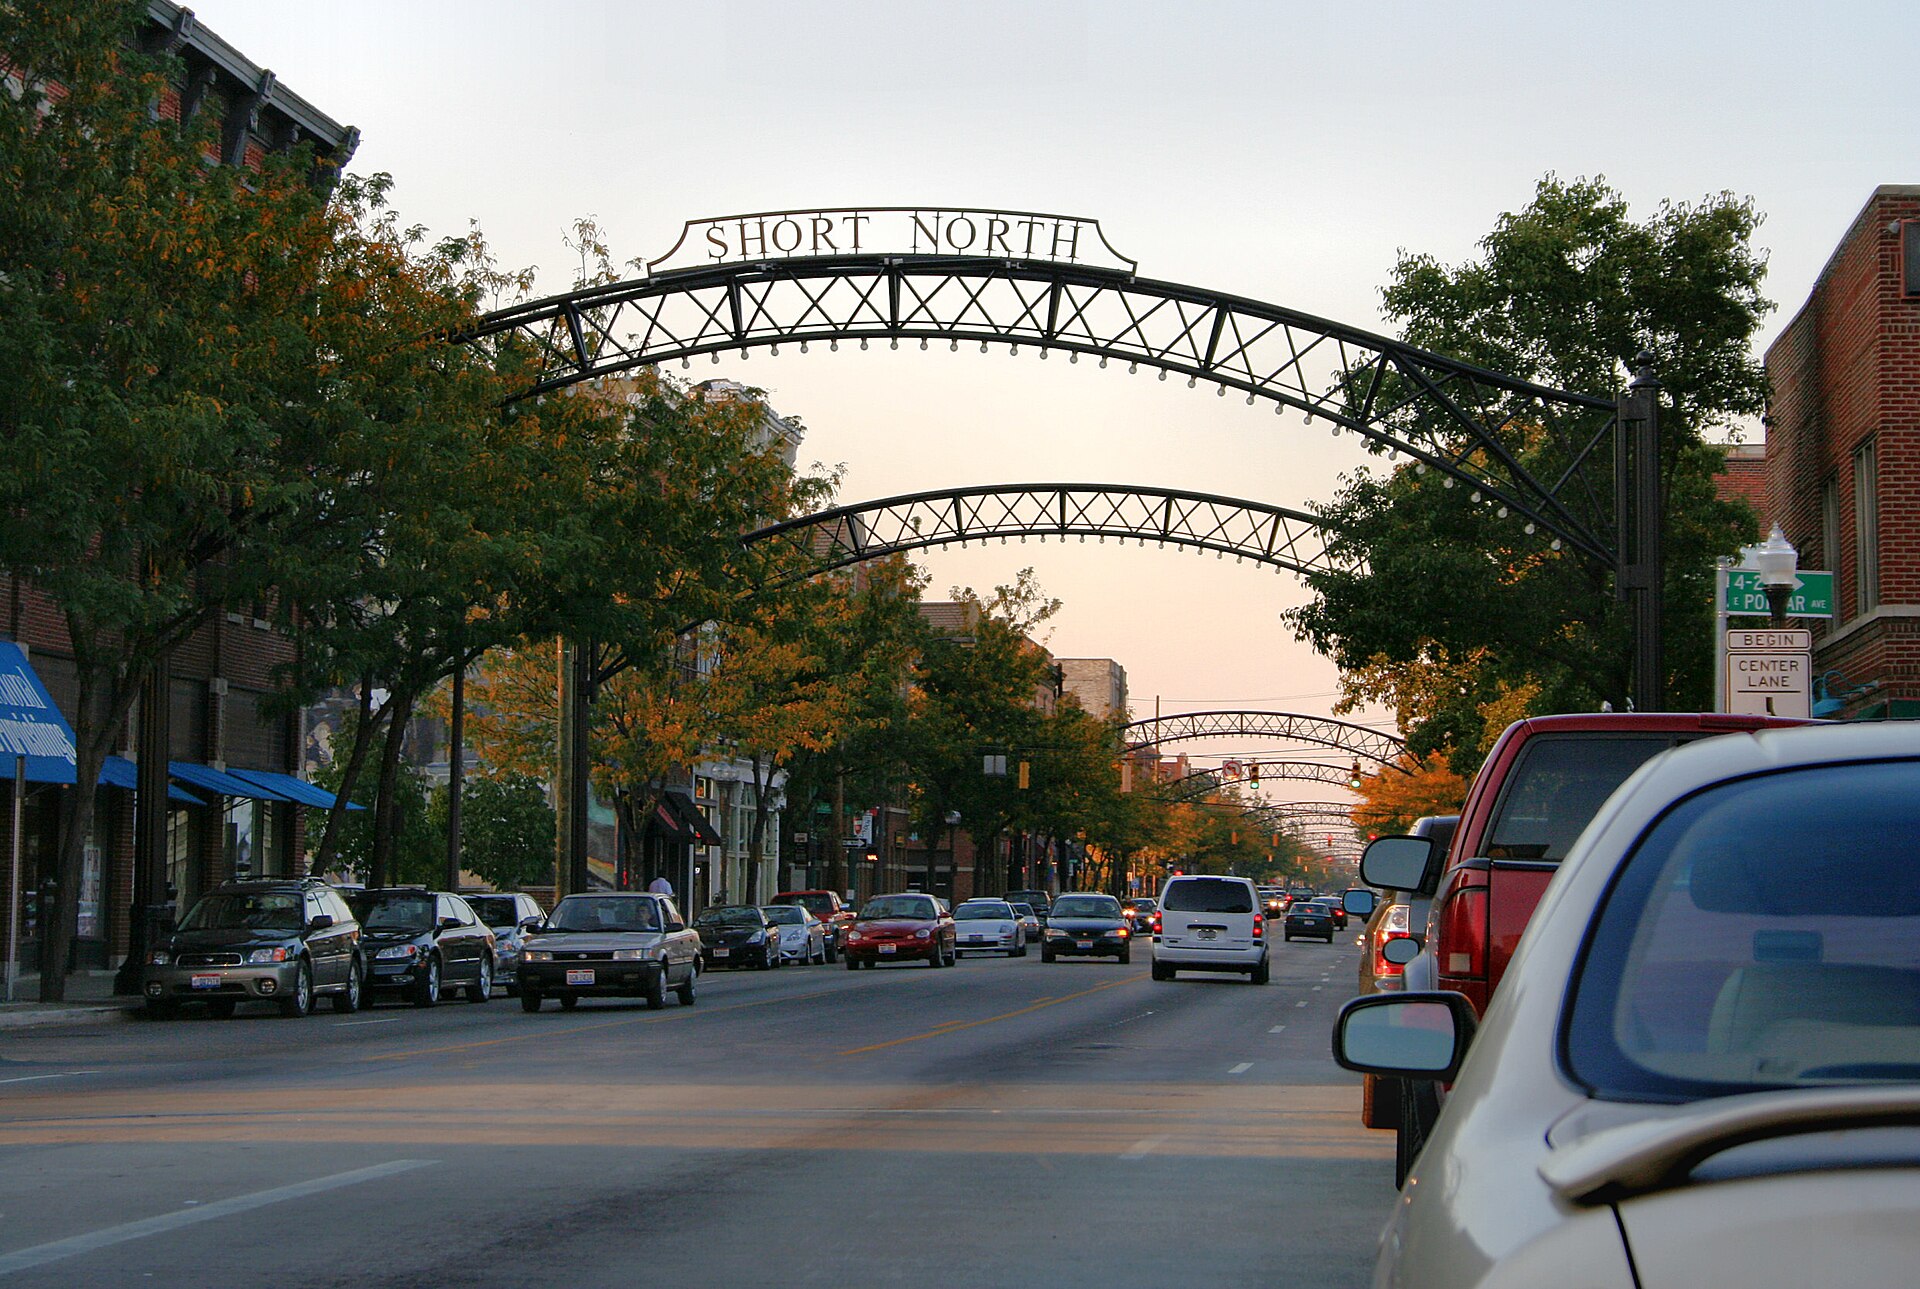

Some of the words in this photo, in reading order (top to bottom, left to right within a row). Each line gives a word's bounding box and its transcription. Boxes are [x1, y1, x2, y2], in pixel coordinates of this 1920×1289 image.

[706, 216, 870, 259] SHORT
[908, 215, 1083, 259] NORTH
[1744, 593, 1806, 612] POAR
[1811, 599, 1827, 609] AVE
[1744, 634, 1794, 646] BEGIN
[1739, 660, 1799, 672] CENTER
[1748, 675, 1790, 687] LANE
